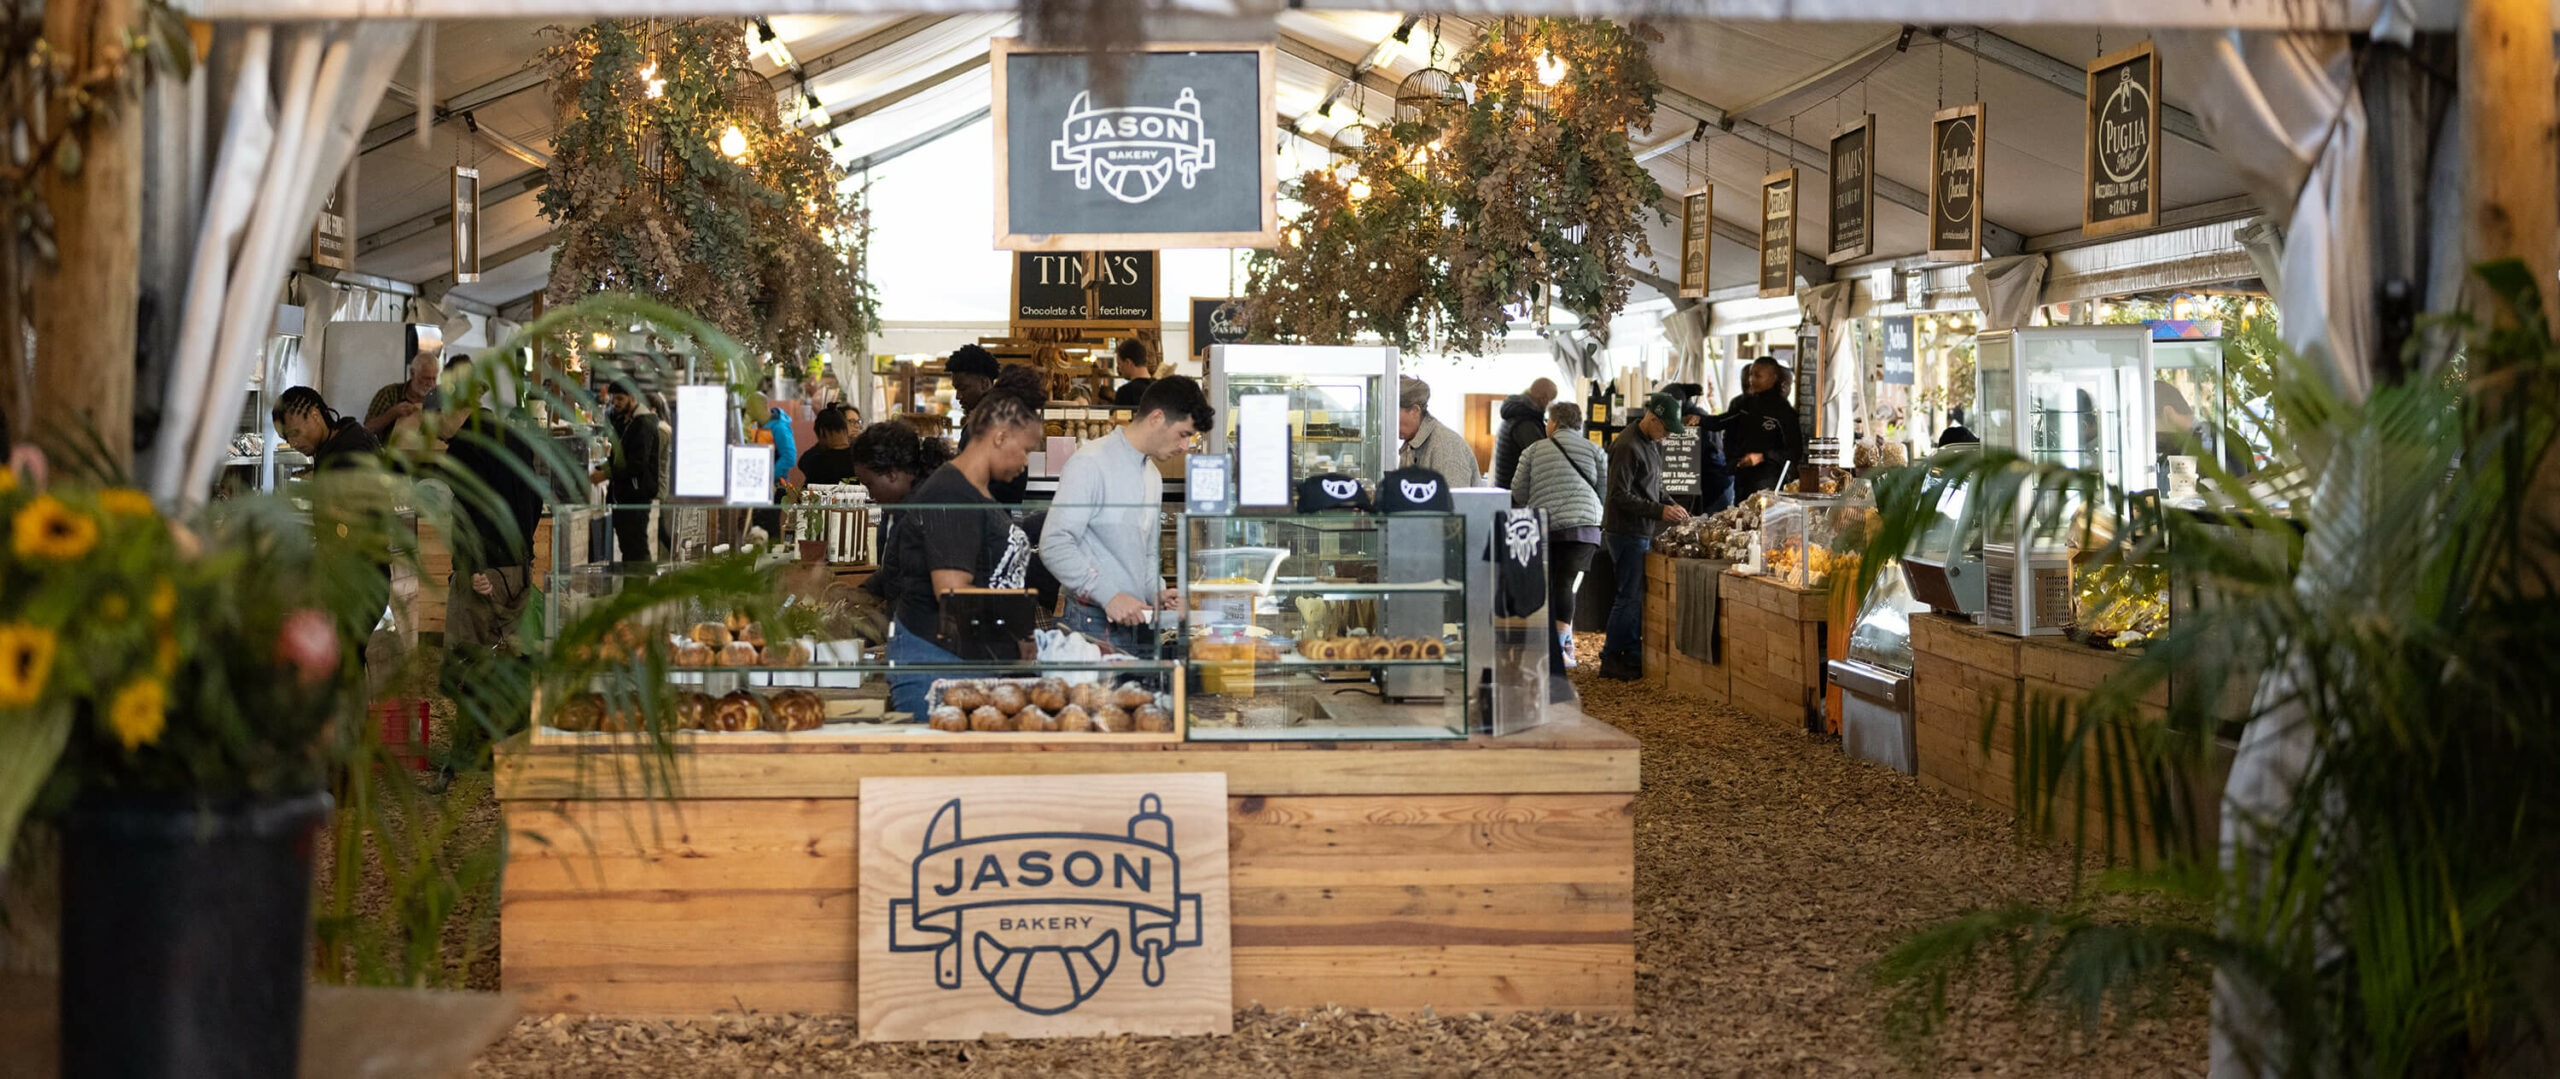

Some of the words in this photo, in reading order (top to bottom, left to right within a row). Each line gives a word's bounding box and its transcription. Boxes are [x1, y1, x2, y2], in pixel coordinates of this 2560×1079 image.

[1073, 116, 1189, 143] JASON
[2106, 117, 2147, 154] PUGLIA
[1108, 150, 1158, 160] BAKERY
[2113, 199, 2131, 216] ITALY
[1021, 306, 1068, 316] Chocolate
[1069, 306, 1076, 315] &
[1080, 306, 1148, 317] Cfectionery
[933, 850, 1152, 897] JASON
[999, 916, 1094, 931] BAKERY
